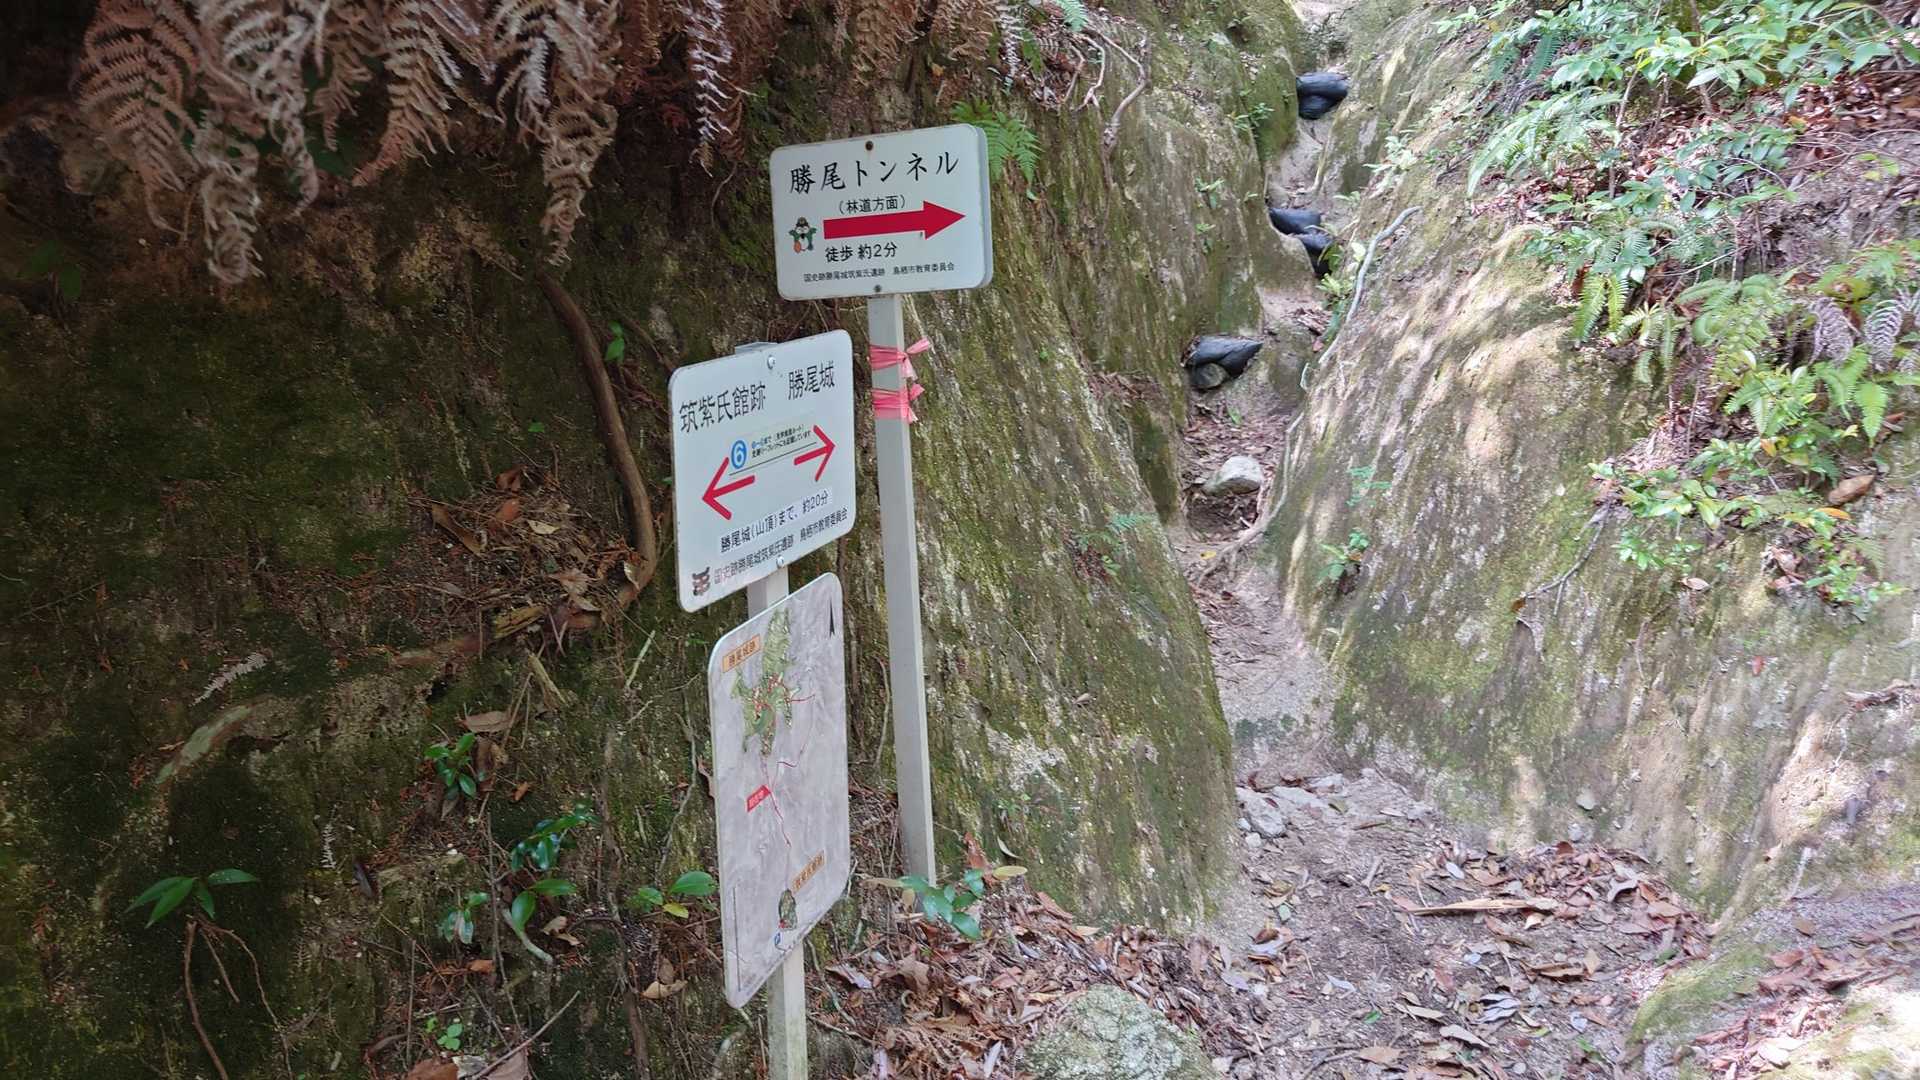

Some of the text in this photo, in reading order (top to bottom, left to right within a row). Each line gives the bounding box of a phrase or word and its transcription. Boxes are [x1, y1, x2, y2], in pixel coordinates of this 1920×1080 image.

[790, 151, 959, 194] 勝尾トンネル
[825, 242, 897, 263] 徒歩 約2分
[679, 360, 835, 433] 筑紫氏館跡 勝尾城
